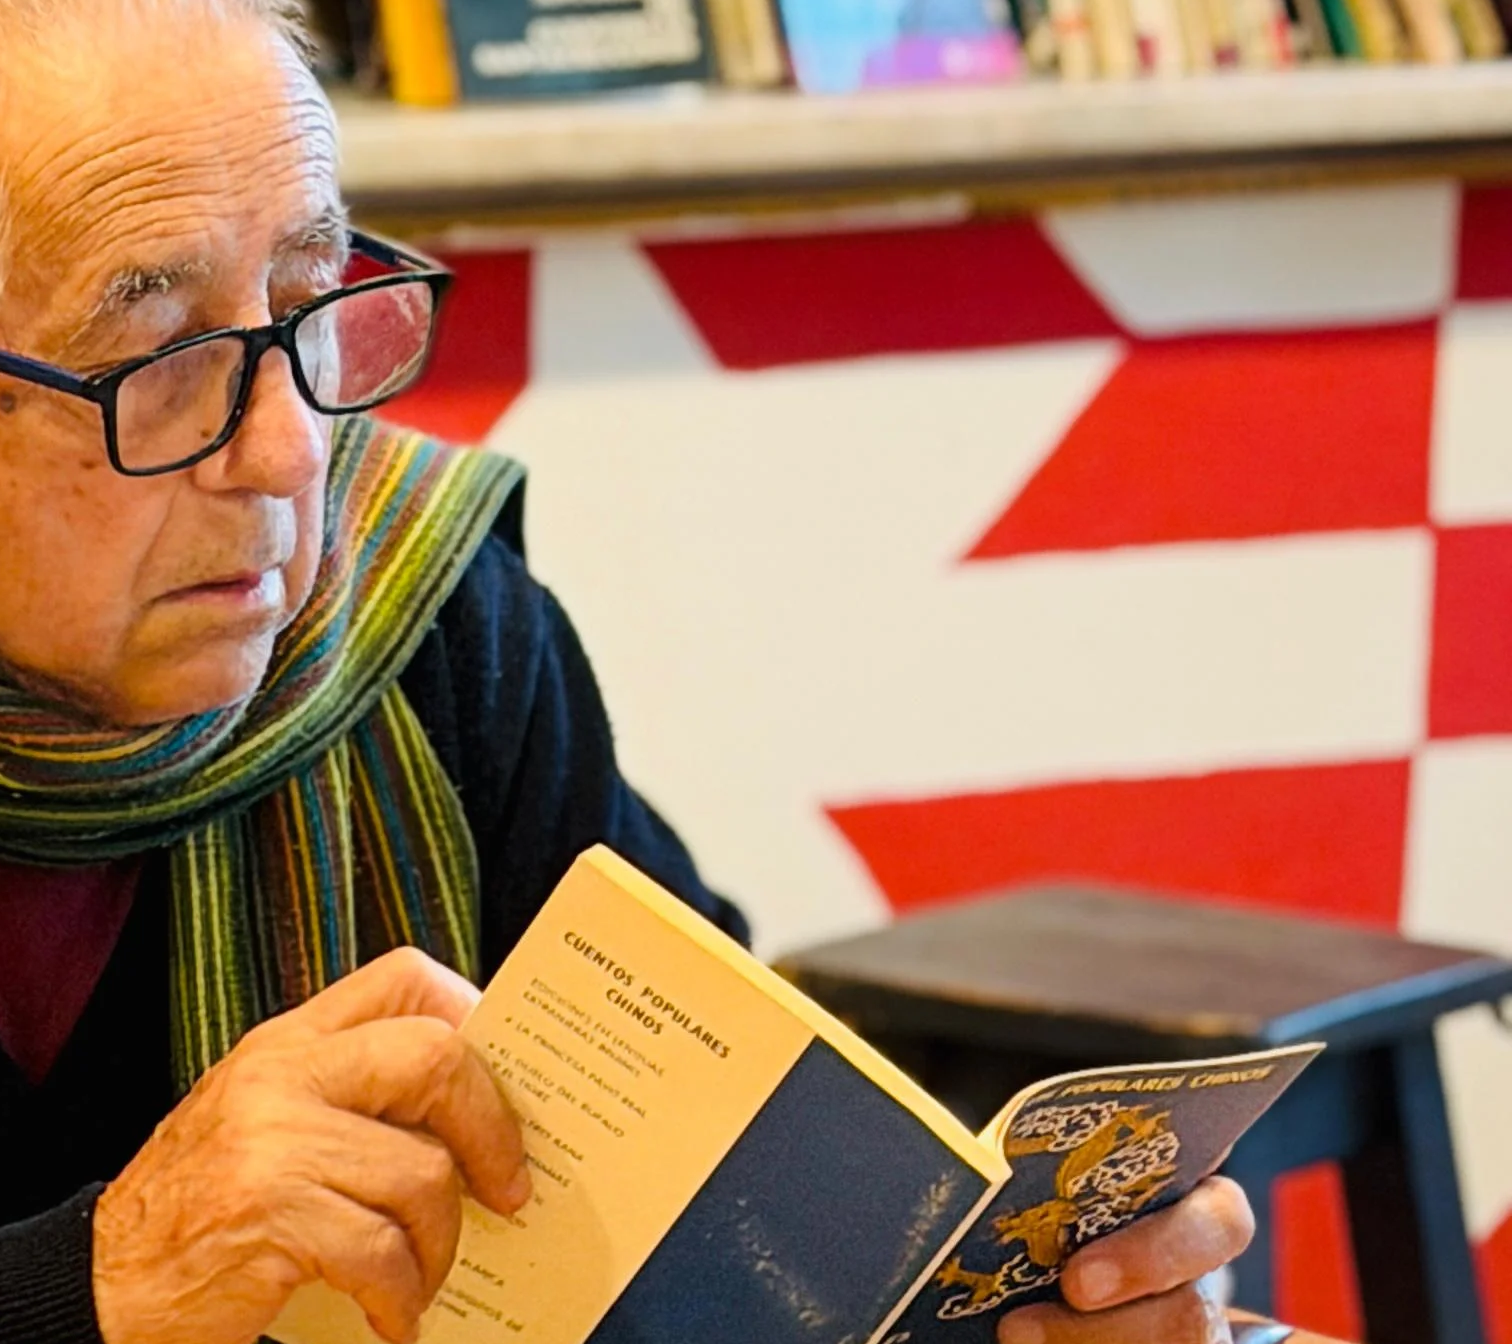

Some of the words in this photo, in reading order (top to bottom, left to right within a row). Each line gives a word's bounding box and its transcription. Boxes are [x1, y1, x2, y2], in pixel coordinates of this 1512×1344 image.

[563, 931, 634, 987] CUENTOS
[639, 986, 731, 1059] POPULARES
[605, 988, 664, 1035] CHINOS
